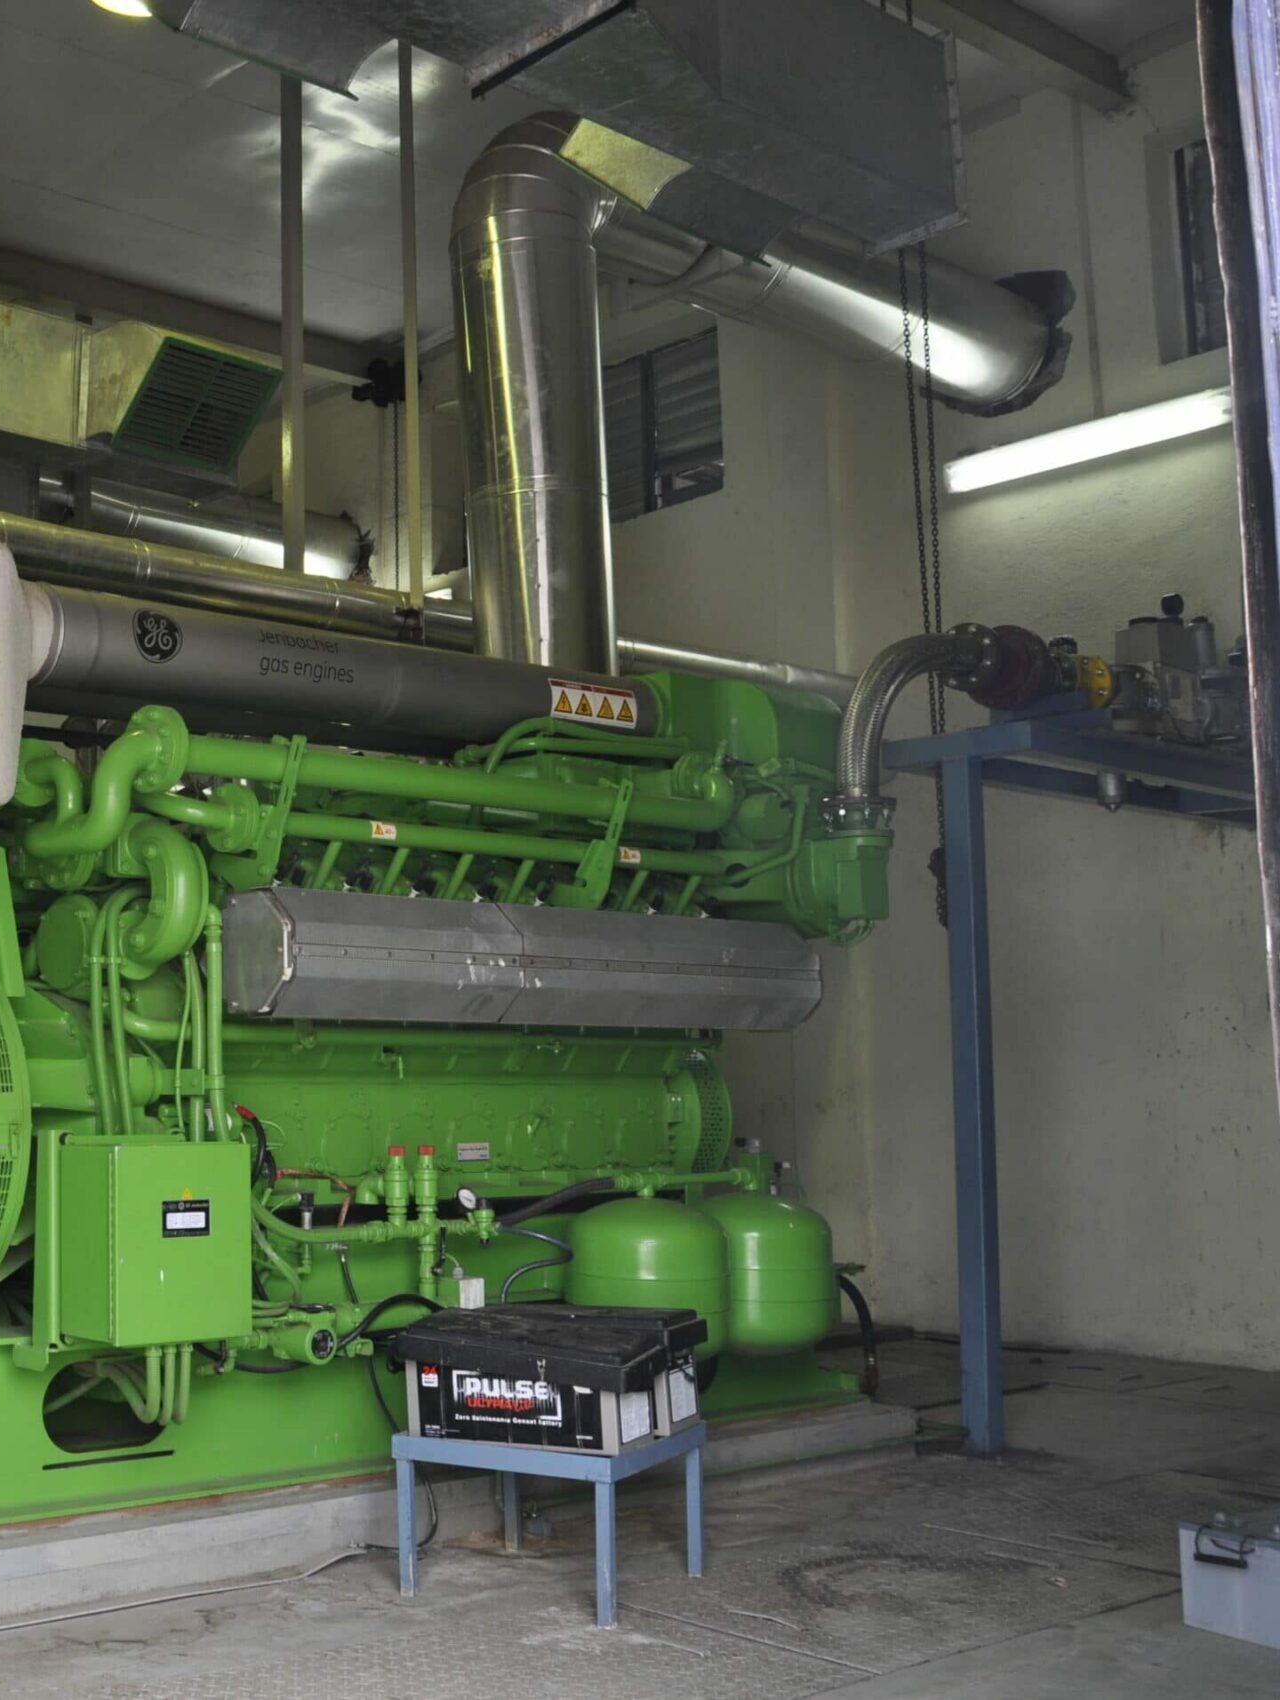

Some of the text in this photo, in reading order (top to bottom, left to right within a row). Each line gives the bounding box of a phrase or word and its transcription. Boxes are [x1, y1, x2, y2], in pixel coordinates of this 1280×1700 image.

[258, 629, 339, 654] Jenbacher
[260, 656, 354, 683] gas engines
[464, 1376, 549, 1400] PULSE
